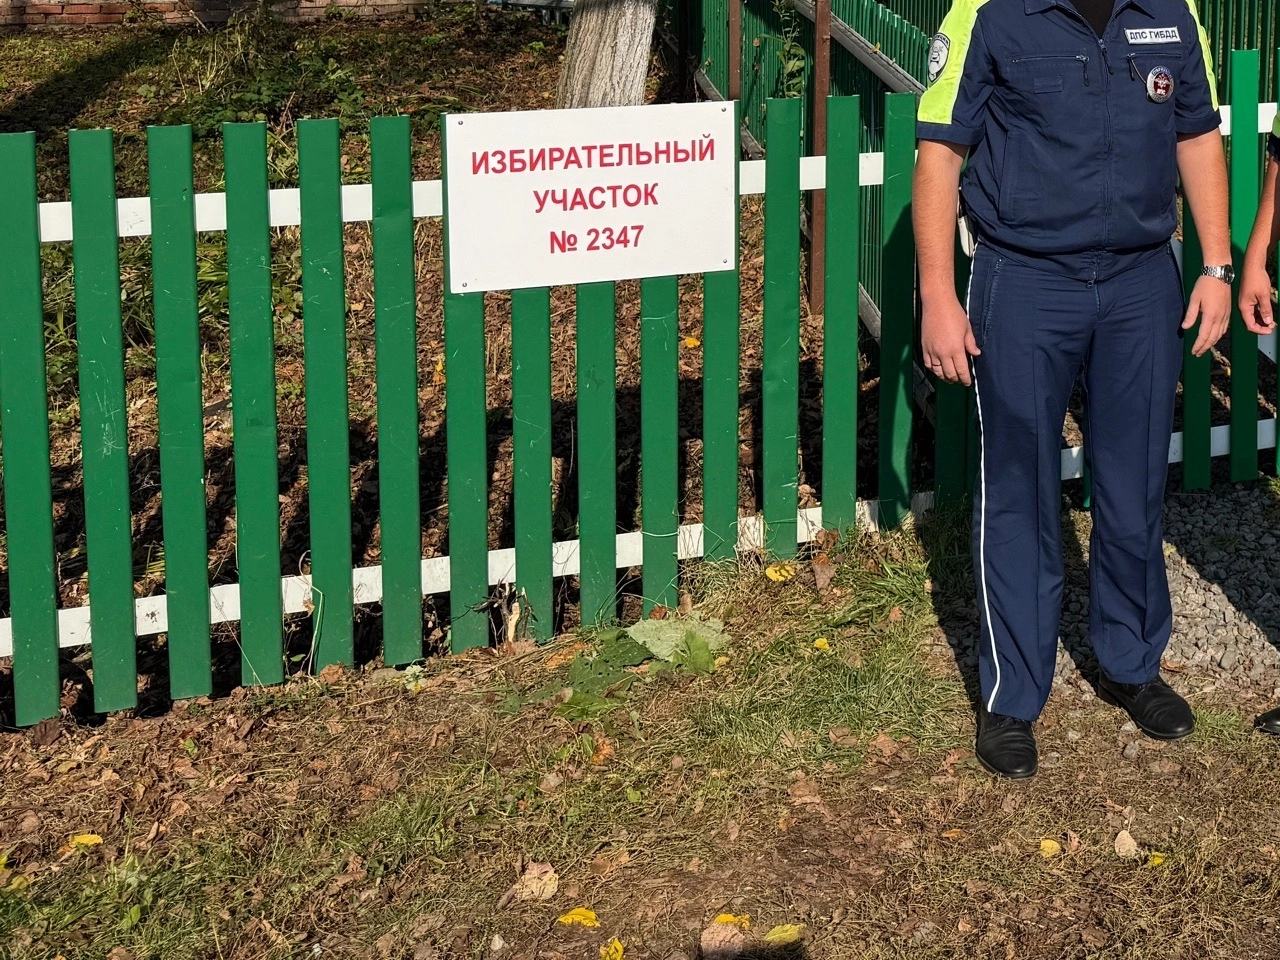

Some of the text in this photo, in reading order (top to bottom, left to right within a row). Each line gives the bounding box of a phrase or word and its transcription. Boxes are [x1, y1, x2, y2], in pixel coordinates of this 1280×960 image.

[1129, 30, 1178, 40] ДПС ГИБДД
[471, 133, 715, 175] ИЗБИРАТЕЛЬНЫЙ
[533, 183, 659, 213] УЧАСТОК
[550, 225, 645, 254] № 2347
